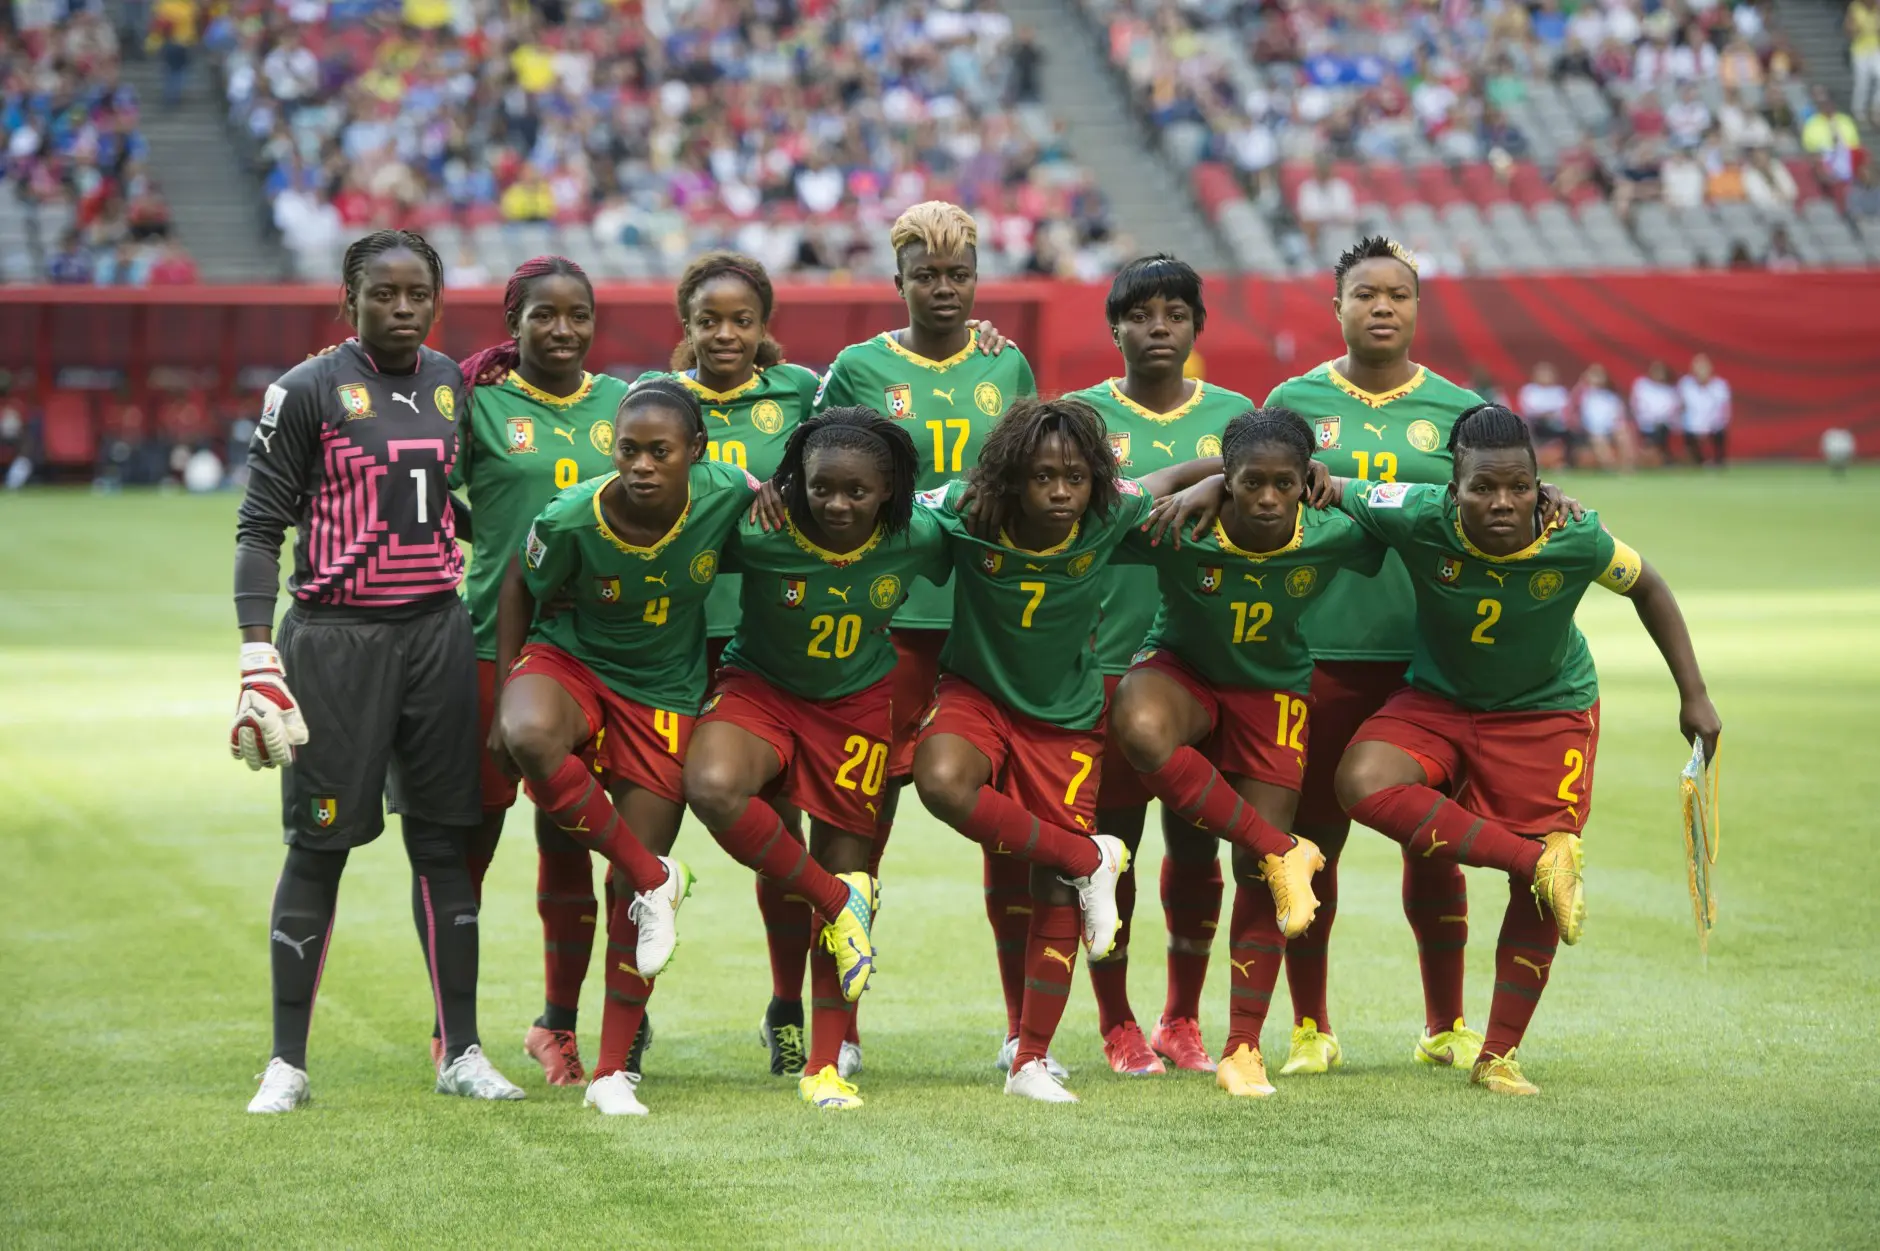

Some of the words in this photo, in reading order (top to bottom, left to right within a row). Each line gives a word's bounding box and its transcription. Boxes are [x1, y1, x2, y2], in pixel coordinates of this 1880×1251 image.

[926, 419, 979, 473] 17
[1352, 451, 1398, 484] 13
[409, 468, 428, 524] 1
[644, 597, 670, 626] 4
[1021, 581, 1046, 628] 7
[1231, 602, 1273, 643] 12
[1472, 598, 1501, 644] 2
[808, 615, 862, 660] 20
[653, 708, 679, 754] 4
[1273, 693, 1308, 752] 12
[835, 735, 888, 797] 20
[1065, 751, 1094, 805] 7
[1557, 749, 1584, 803] 2
